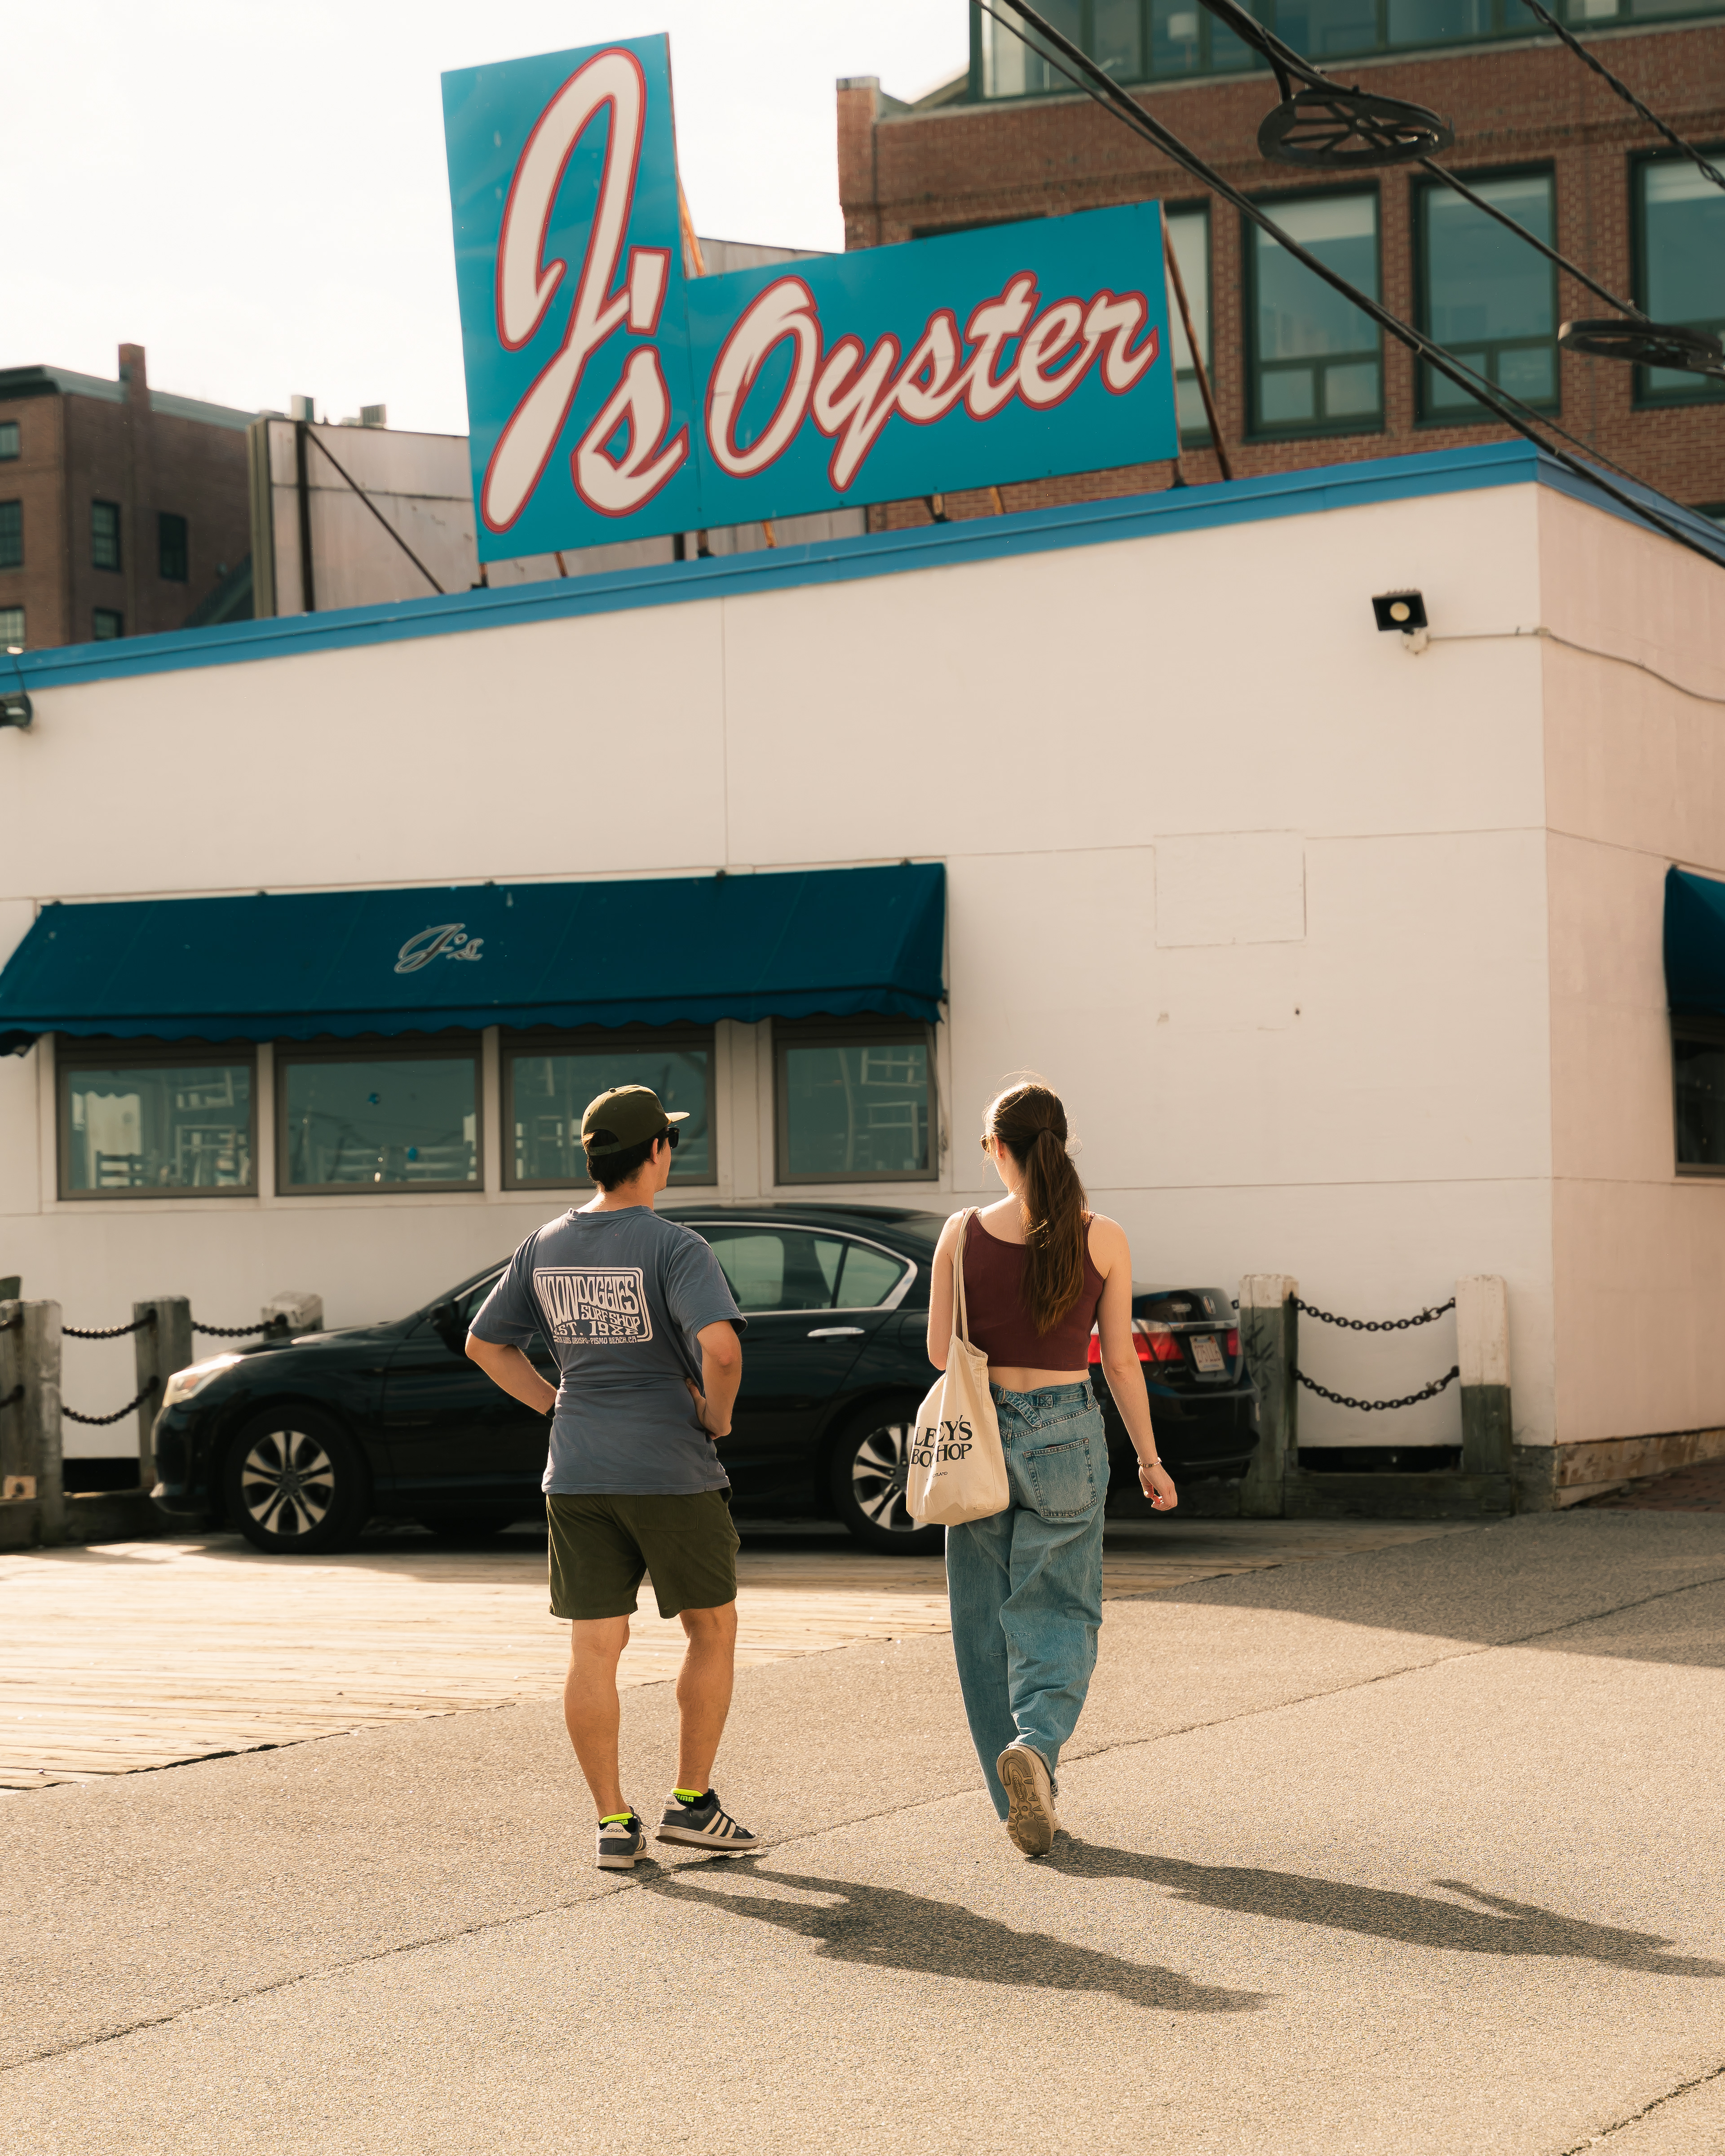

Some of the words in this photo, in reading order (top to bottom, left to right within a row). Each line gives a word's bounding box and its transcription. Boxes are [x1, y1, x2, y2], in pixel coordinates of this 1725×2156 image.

[481, 47, 690, 534] J's
[705, 270, 1159, 492] Oyster
[394, 923, 484, 974] J's
[580, 1304, 608, 1322] SURF
[608, 1312, 641, 1331] SHOP
